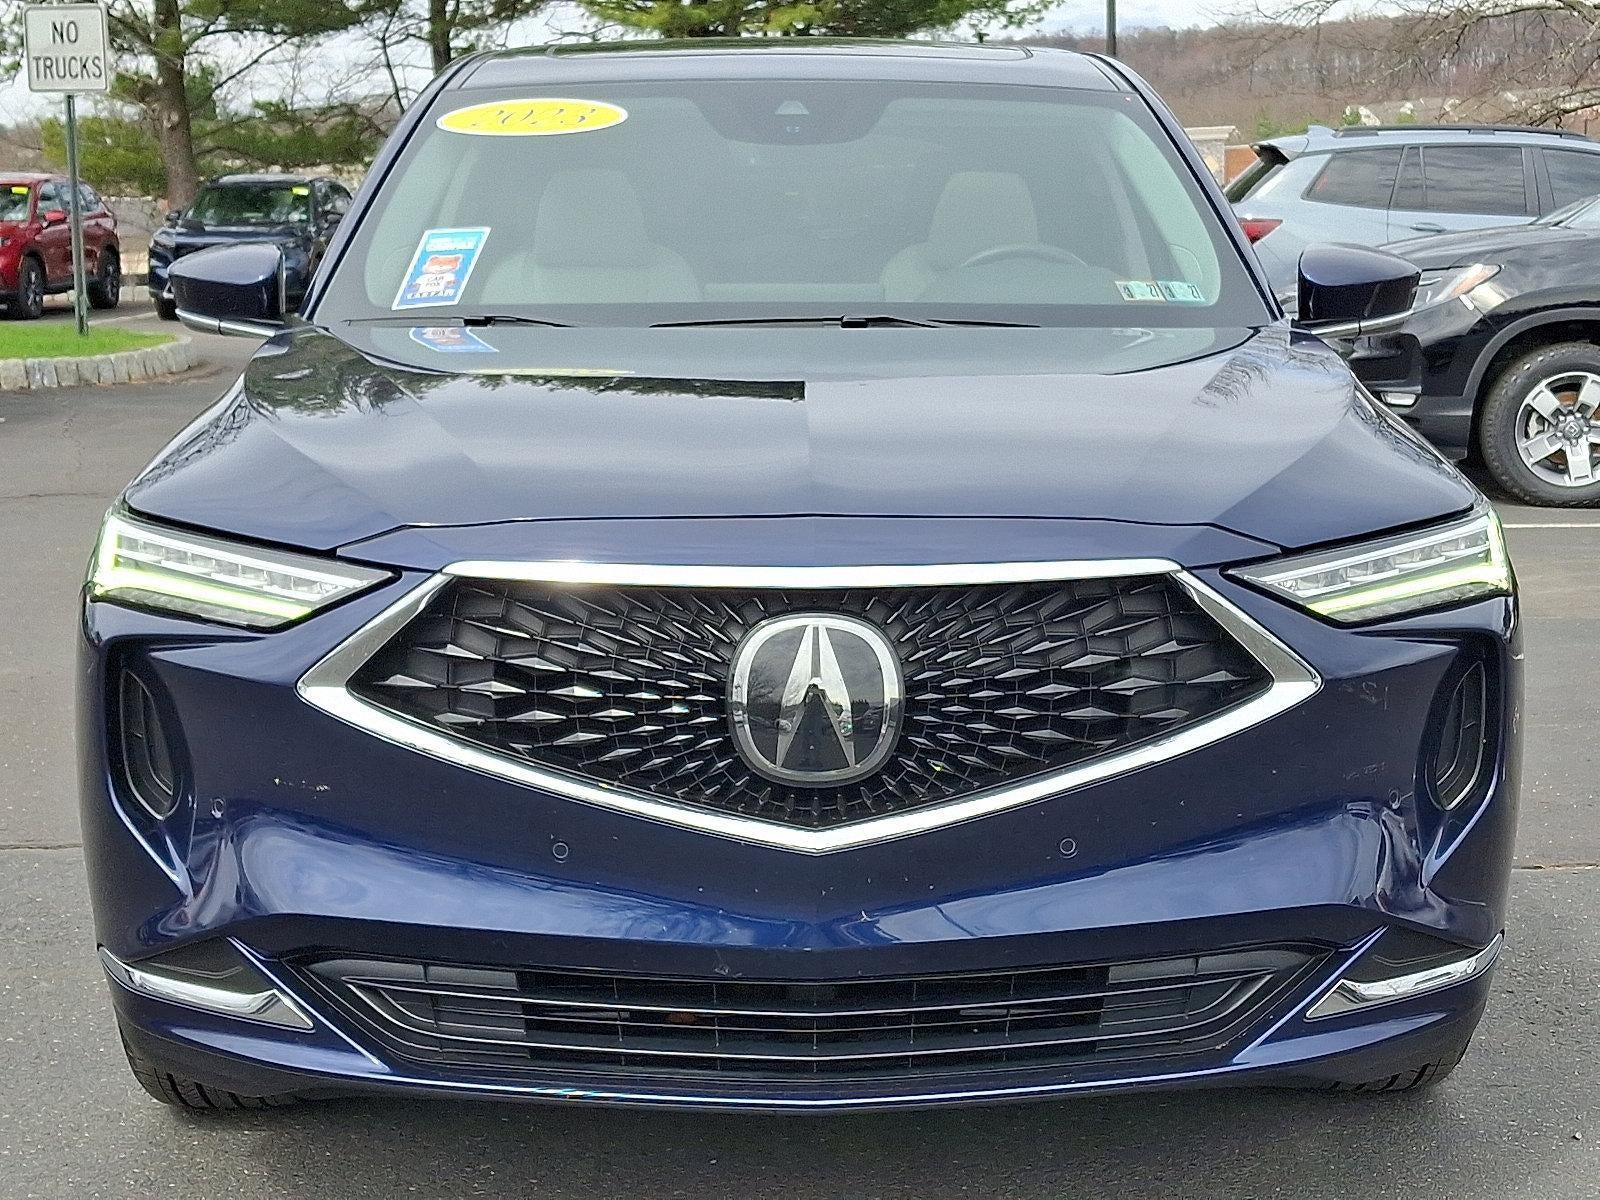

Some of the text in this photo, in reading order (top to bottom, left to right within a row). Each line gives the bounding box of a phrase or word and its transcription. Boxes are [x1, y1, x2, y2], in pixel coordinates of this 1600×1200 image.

[52, 20, 78, 44] NO
[33, 56, 102, 80] TRUCKS
[470, 107, 596, 126] 2023
